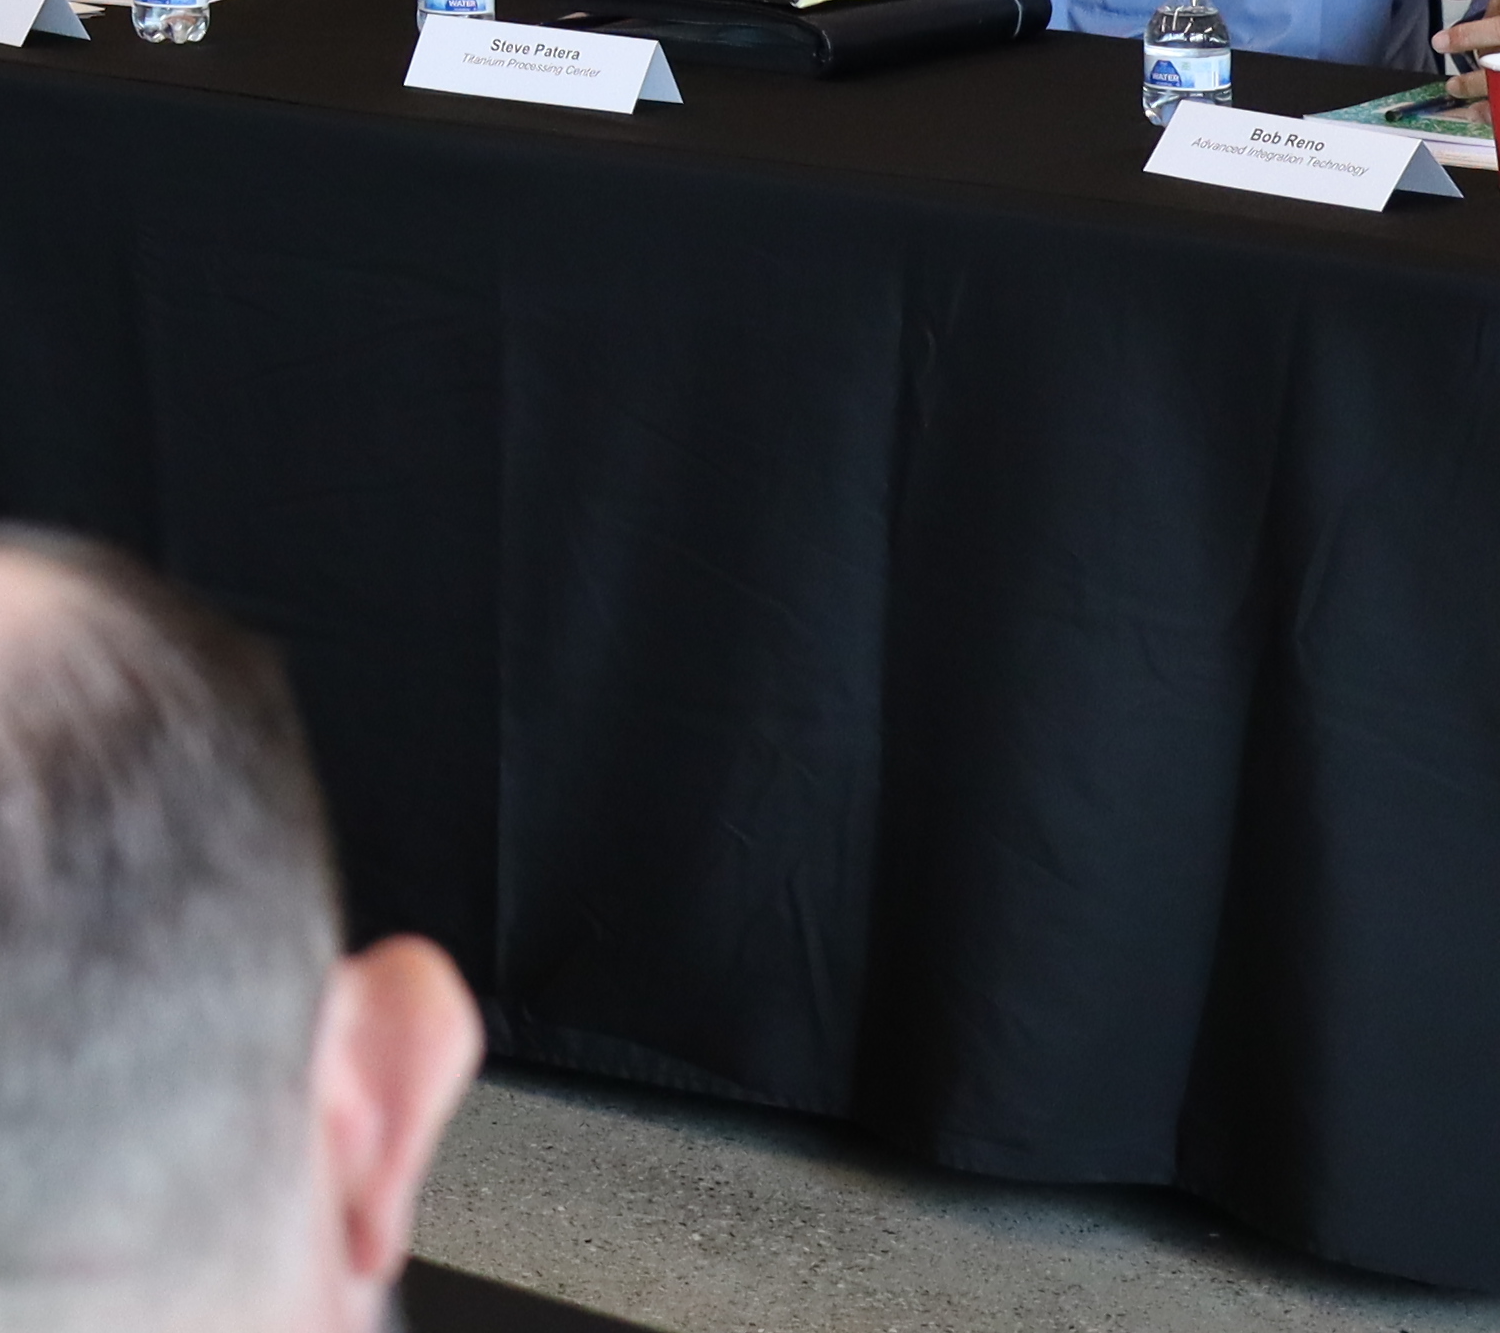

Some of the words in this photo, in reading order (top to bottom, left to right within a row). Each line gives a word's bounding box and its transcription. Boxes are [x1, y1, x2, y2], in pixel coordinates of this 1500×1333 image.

[448, 0, 477, 8] WATER
[490, 38, 532, 56] Steve
[533, 43, 581, 61] Patera
[462, 52, 505, 69] Titanium
[506, 58, 564, 77] Processing
[565, 65, 602, 79] Center
[1250, 127, 1283, 147] Bob
[1284, 133, 1326, 153] Reno
[1190, 136, 1247, 157] Advanced
[1247, 146, 1305, 166] Integration
[1306, 154, 1370, 178] Technology
